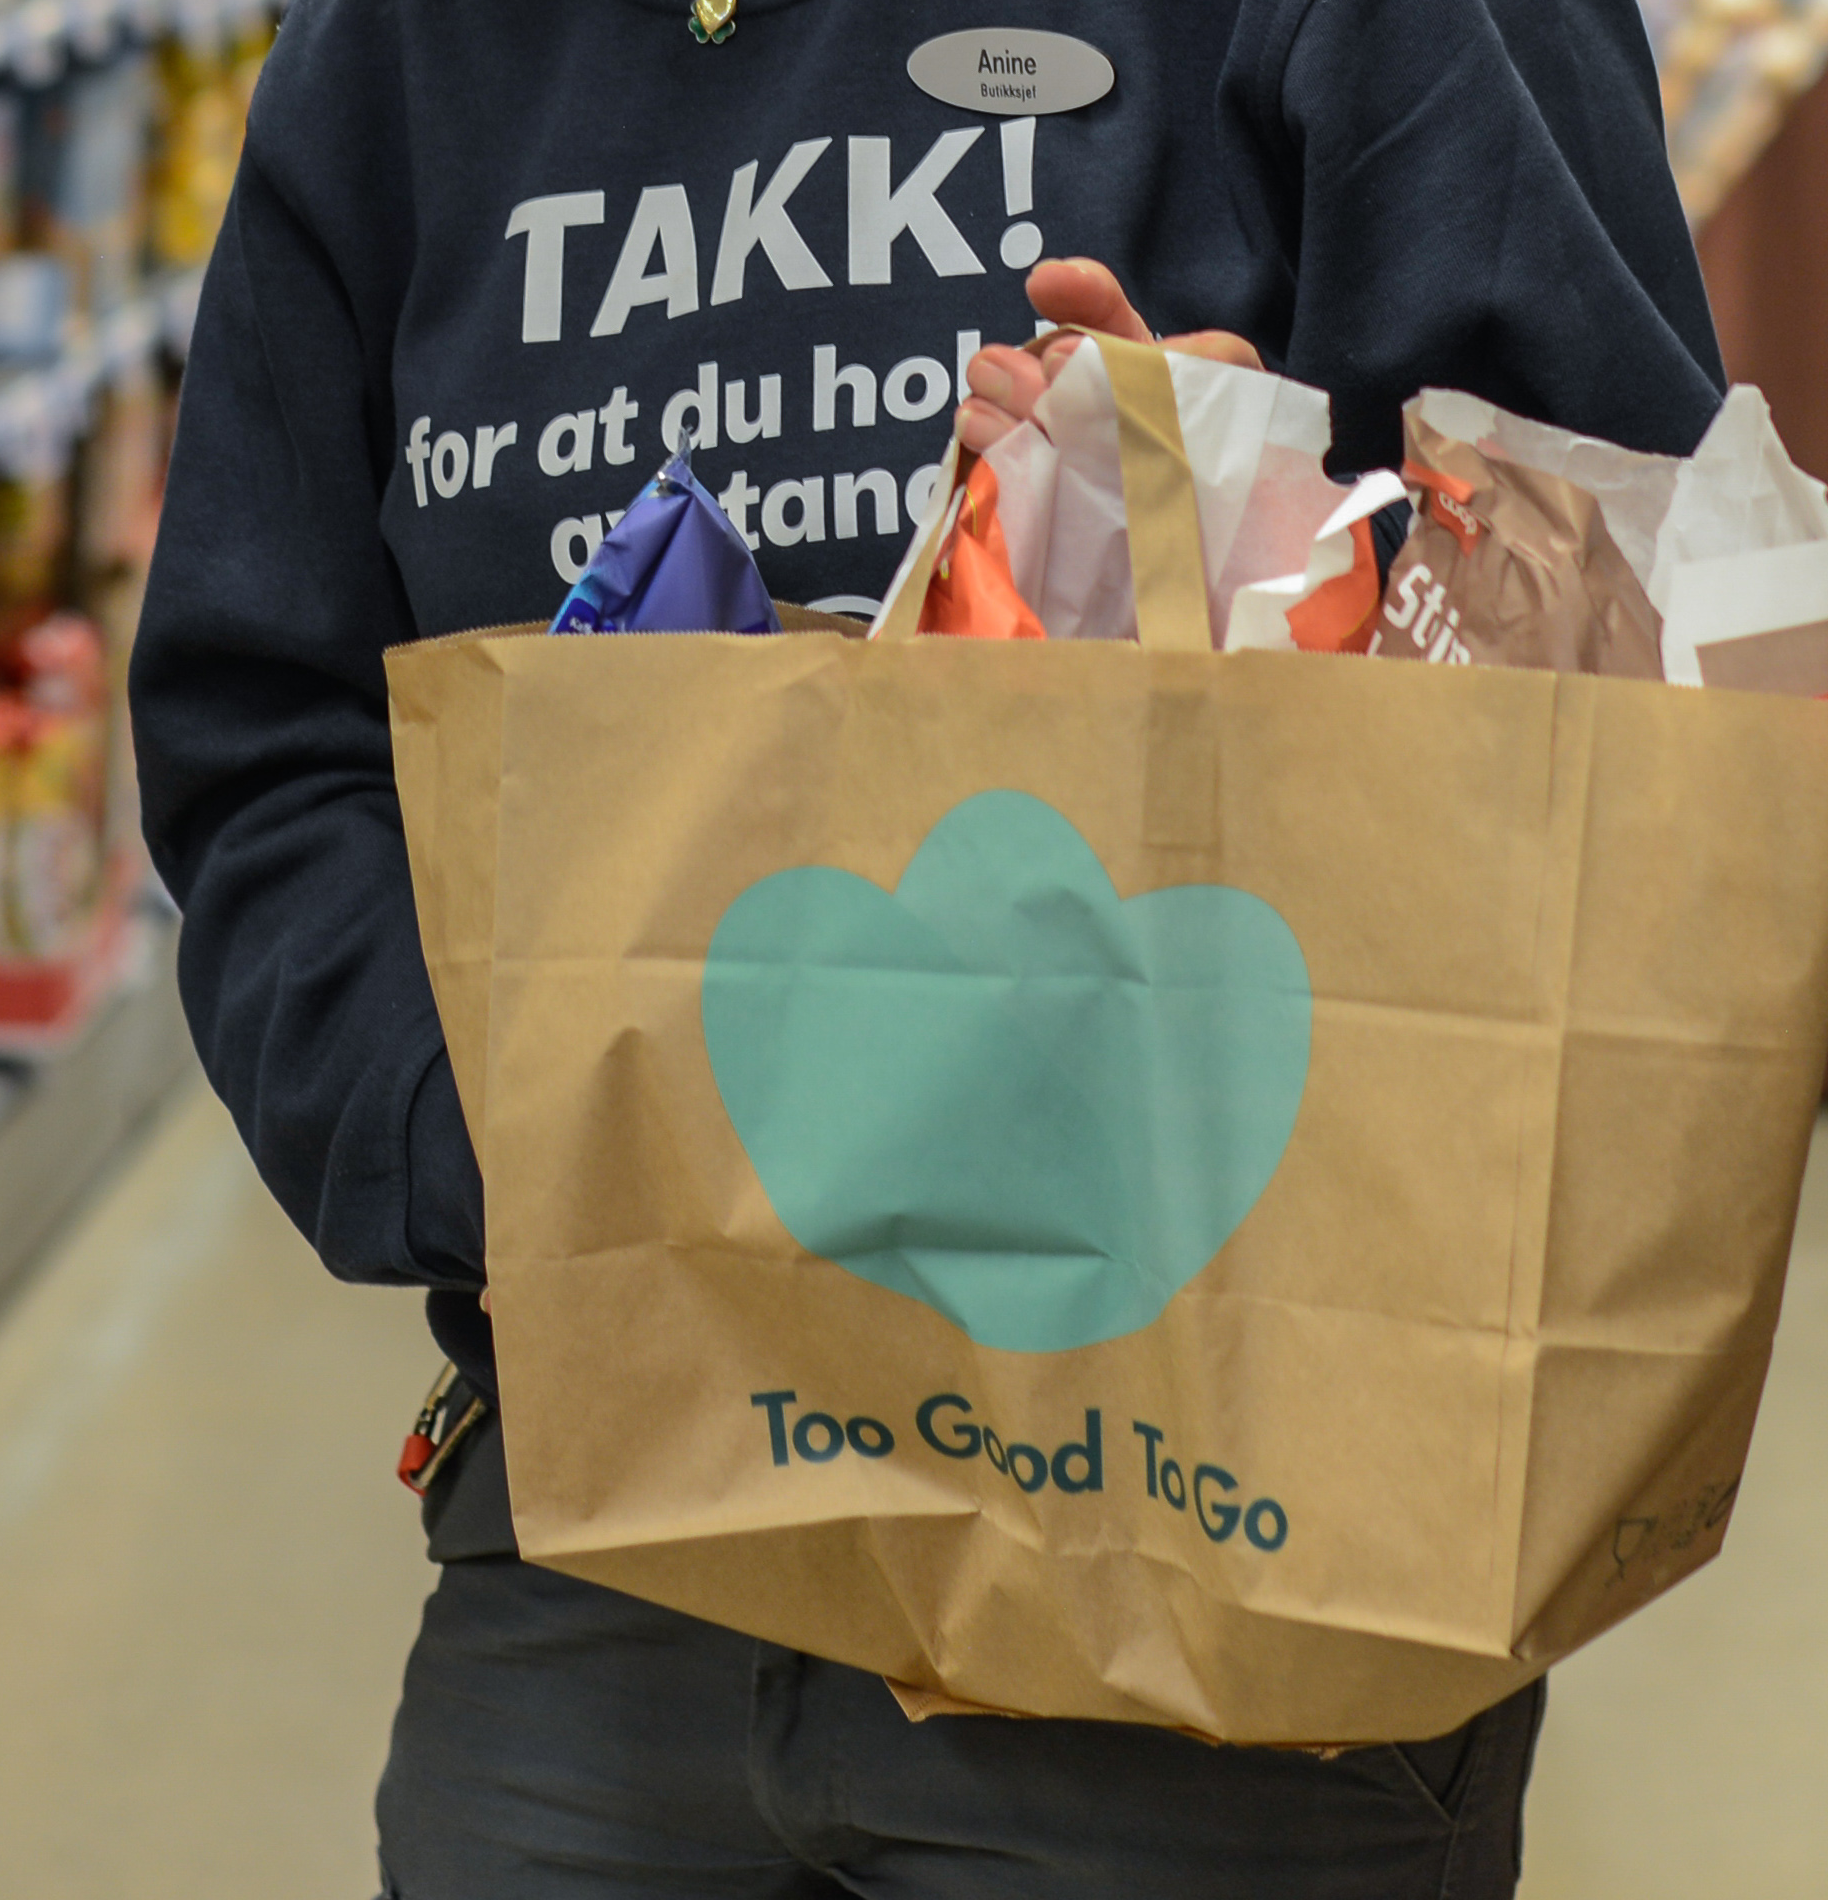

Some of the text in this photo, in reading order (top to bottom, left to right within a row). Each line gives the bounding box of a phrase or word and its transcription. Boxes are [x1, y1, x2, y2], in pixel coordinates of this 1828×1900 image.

[977, 48, 1038, 77] Anine
[980, 82, 1038, 103] Butikksjef
[504, 116, 1044, 344] TAKK!
[405, 415, 517, 508] for
[537, 386, 639, 478] at
[660, 362, 783, 452] du
[750, 1389, 1289, 1553] Too Good To Go
